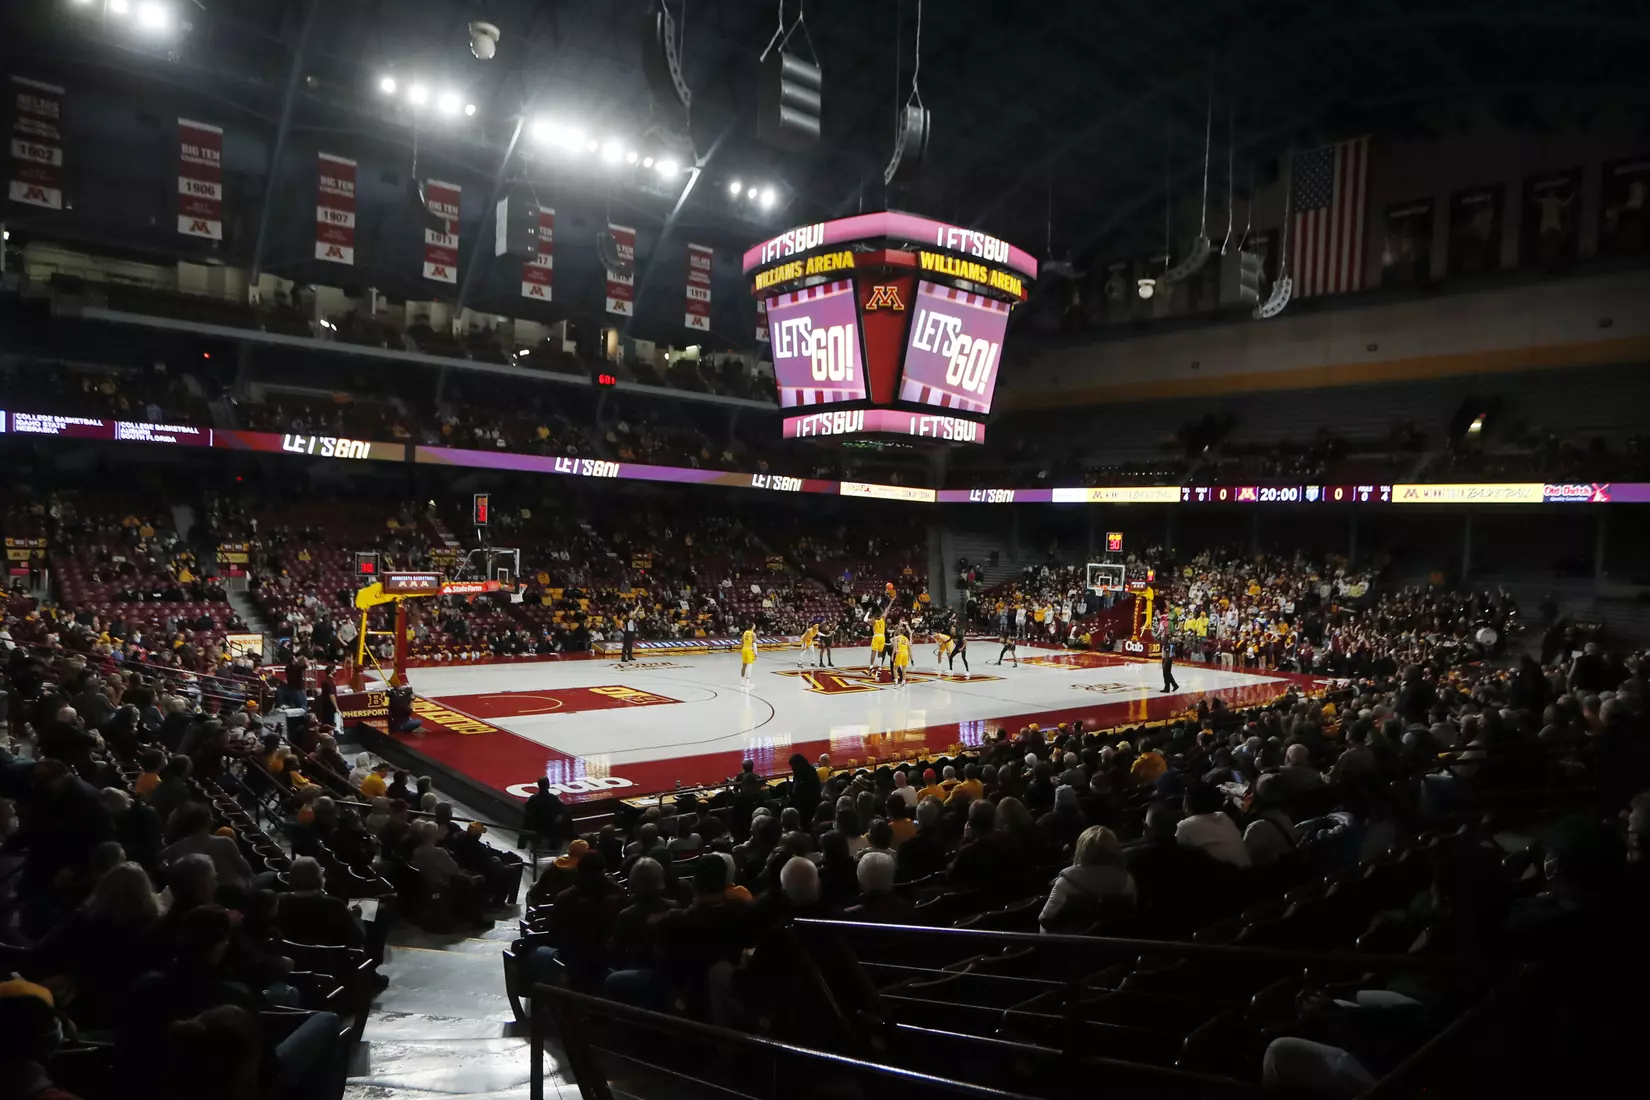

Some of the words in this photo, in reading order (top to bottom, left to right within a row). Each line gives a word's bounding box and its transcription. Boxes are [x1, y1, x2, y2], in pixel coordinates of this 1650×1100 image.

[20, 144, 54, 160] 1902
[181, 144, 199, 156] BIG
[201, 147, 220, 160] TEN
[186, 182, 215, 196] 1906
[320, 176, 336, 187] BIG
[337, 178, 354, 191] TEN
[443, 203, 458, 214] TEN
[324, 210, 348, 224] 1907
[755, 260, 802, 290] WILLIAMS
[805, 250, 854, 276] ARENA
[920, 251, 988, 282] WILLIAMS
[990, 268, 1022, 295] ARENA
[691, 289, 706, 299] 1919
[866, 286, 904, 310] M
[774, 316, 812, 359] LET'S
[912, 309, 963, 358] LET'S
[811, 324, 854, 382] GO!
[946, 333, 1000, 395] GO!
[16, 412, 54, 422] COLLEGE
[54, 415, 104, 426] BASKETBALL
[42, 421, 66, 429] STATE
[16, 426, 59, 434] NEBRASKA
[120, 421, 154, 430] COLLEGE
[155, 424, 199, 434] BASKETBALL
[1183, 493, 1189, 501] 4
[1198, 493, 1204, 501] 0
[1220, 489, 1227, 500] 0
[1260, 488, 1297, 501] 20:00
[1334, 488, 1343, 500] 0
[1361, 492, 1368, 501] 0
[1381, 492, 1388, 501] 4
[1544, 485, 1561, 496] Old
[1562, 484, 1591, 496] Dutch
[1110, 540, 1119, 549] 30
[637, 640, 709, 649] MINNESOTA
[1126, 641, 1143, 652] Cub
[342, 708, 389, 718] PHERSPORT
[506, 777, 633, 798] Cub
